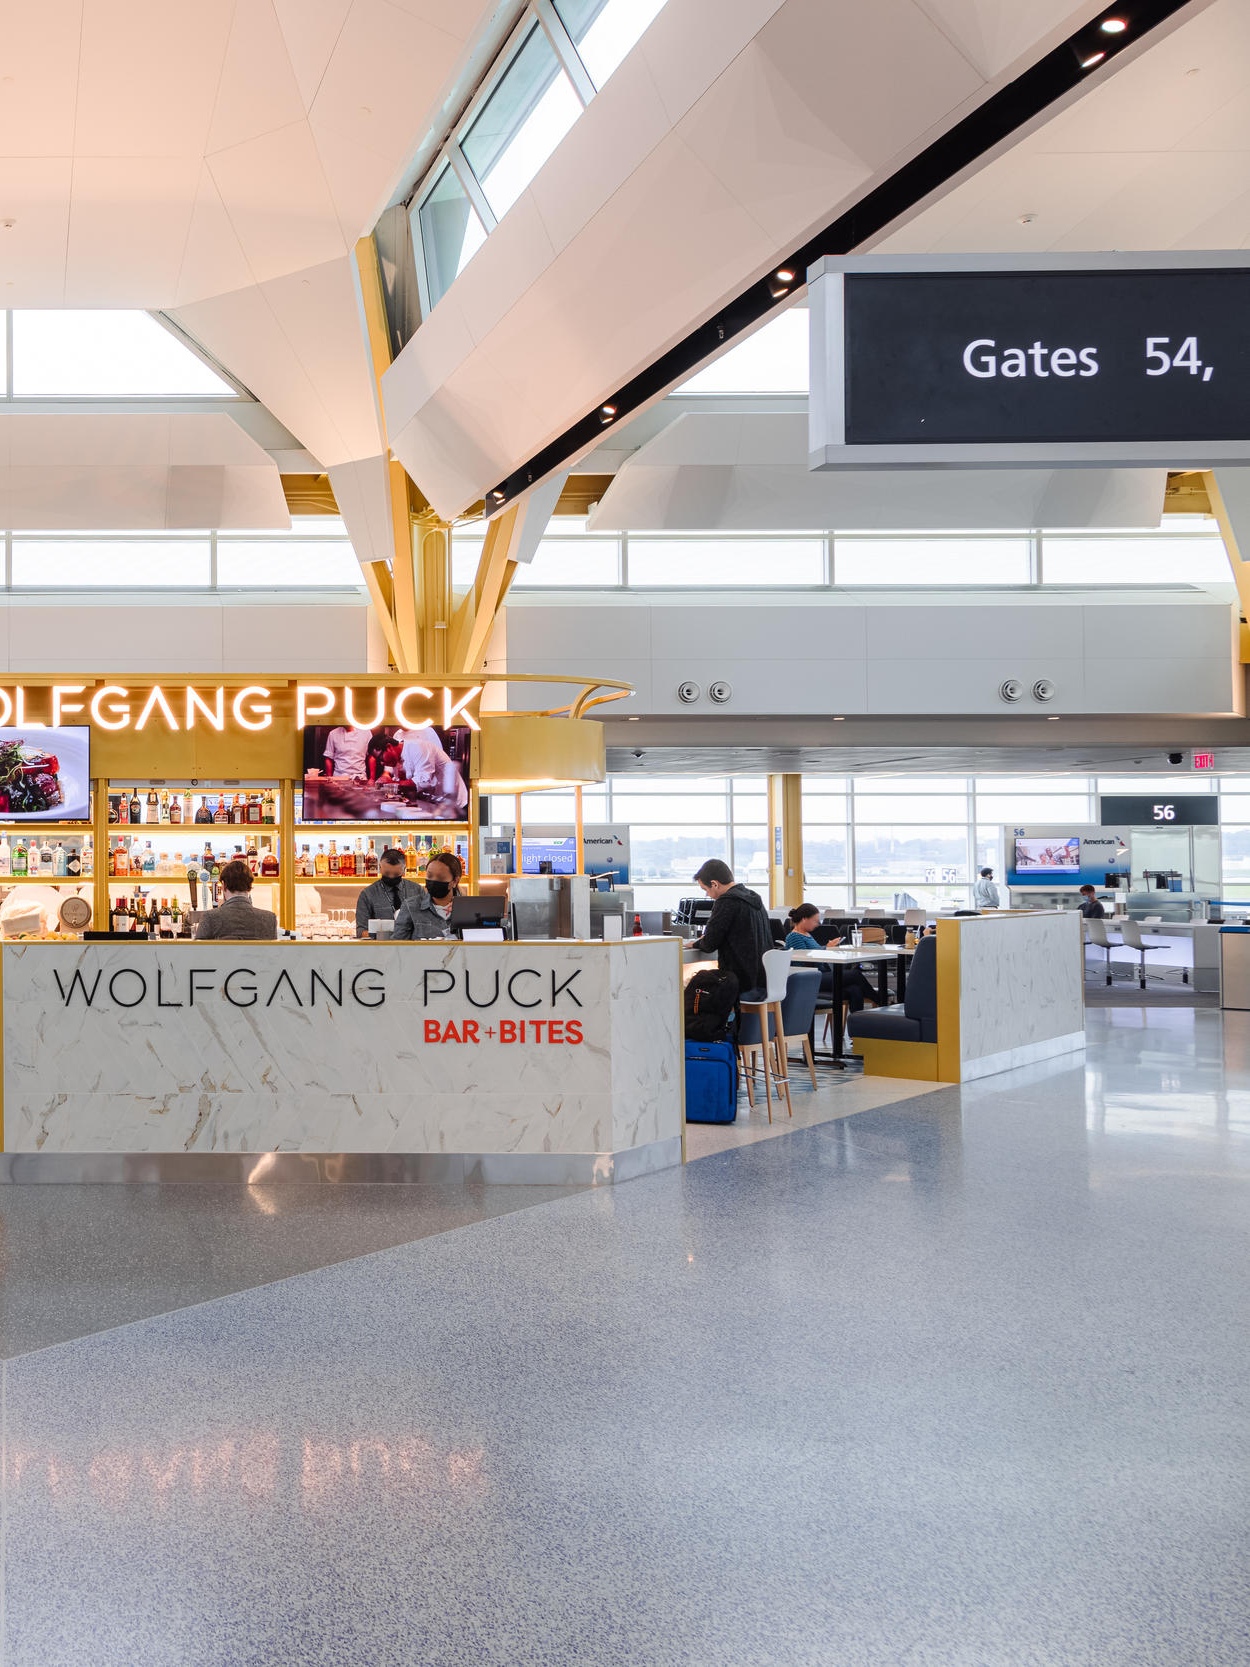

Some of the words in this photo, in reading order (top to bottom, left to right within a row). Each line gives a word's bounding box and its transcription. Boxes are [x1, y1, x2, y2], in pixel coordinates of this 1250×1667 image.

[963, 337, 1099, 378] Gates
[1146, 336, 1214, 382] 54,
[296, 685, 482, 731] PUCK
[1194, 754, 1210, 769] EXIT
[1153, 804, 1176, 821] 56
[1013, 828, 1025, 837] 56
[249, 860, 257, 872] 7
[521, 853, 542, 865] light
[543, 853, 573, 863] closed
[53, 968, 386, 1008] WOLFGANG
[423, 968, 583, 1008] PUCK
